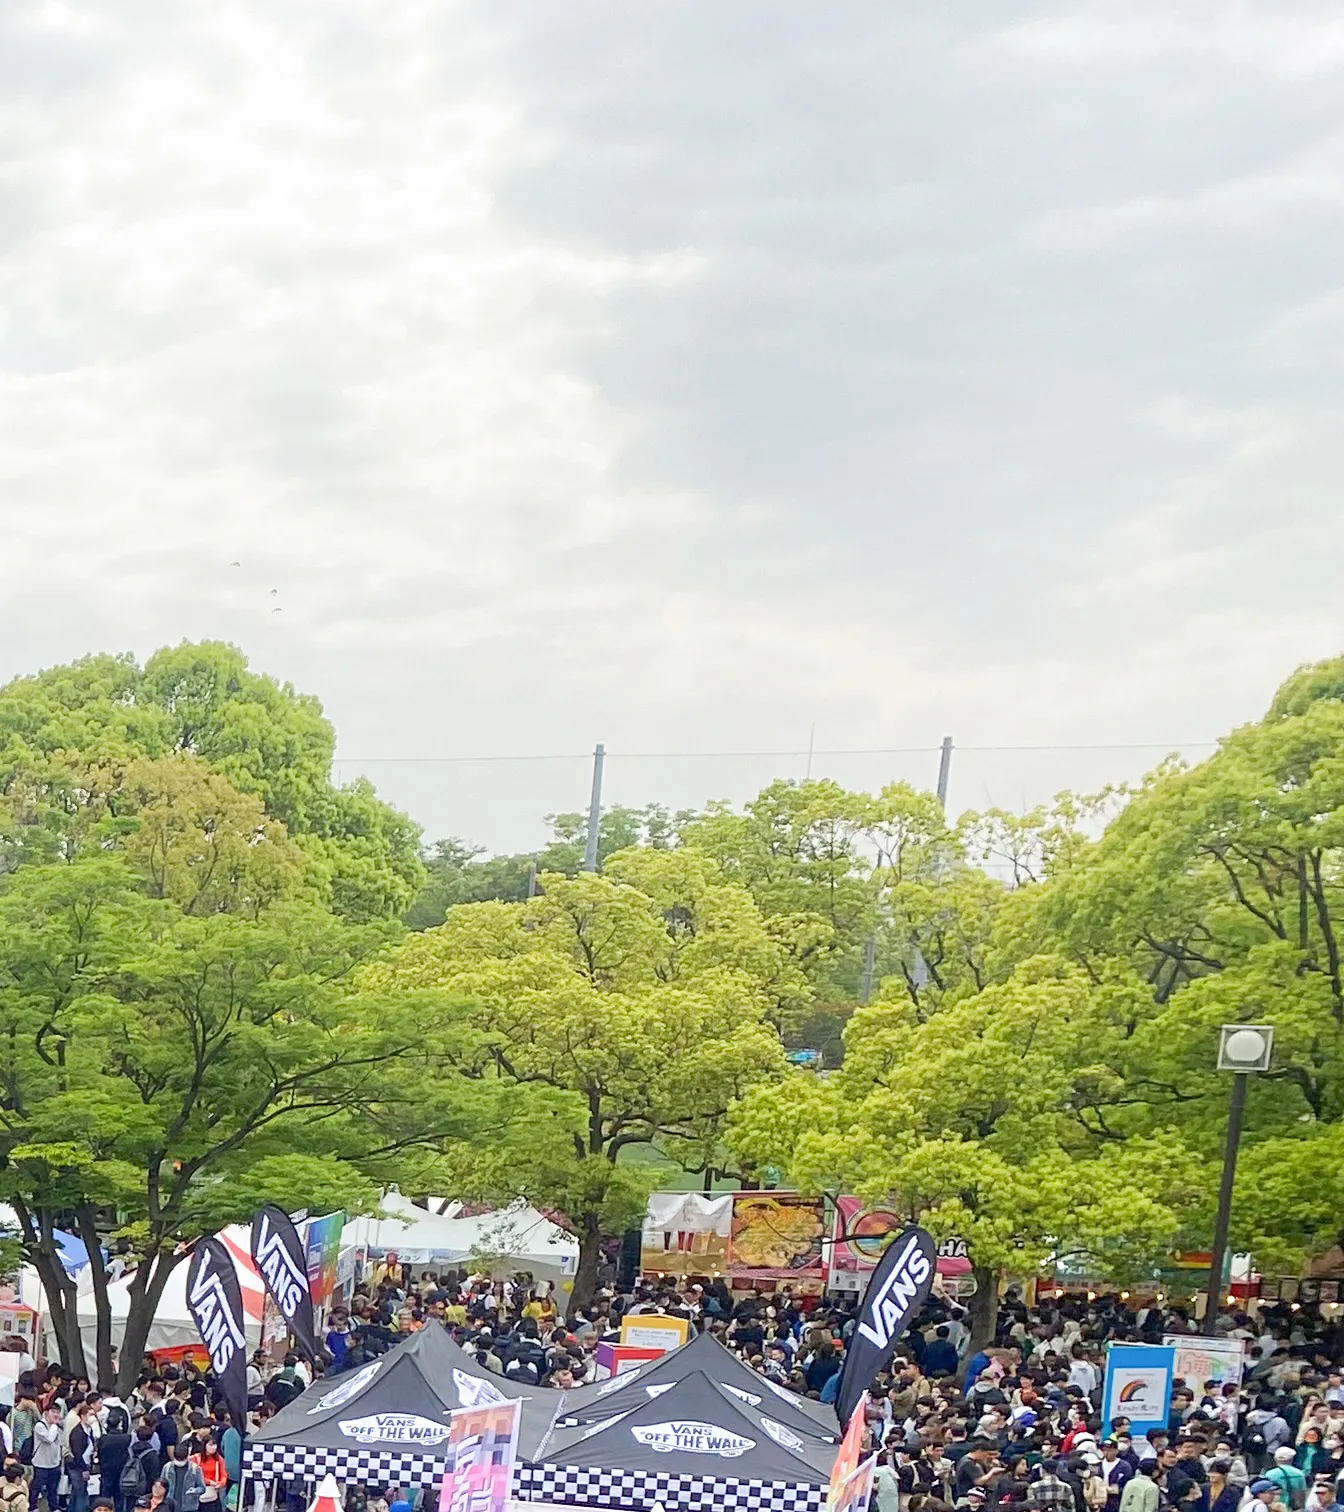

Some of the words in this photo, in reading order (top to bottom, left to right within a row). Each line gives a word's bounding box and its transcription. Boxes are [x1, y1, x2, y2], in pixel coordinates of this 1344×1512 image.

[255, 1214, 309, 1317] VANS
[858, 1235, 930, 1350] VANS
[190, 1247, 246, 1374] VANS
[375, 1416, 416, 1427] VANS
[379, 1426, 406, 1438] THE
[671, 1423, 713, 1435] VANS
[675, 1435, 705, 1448] THE
